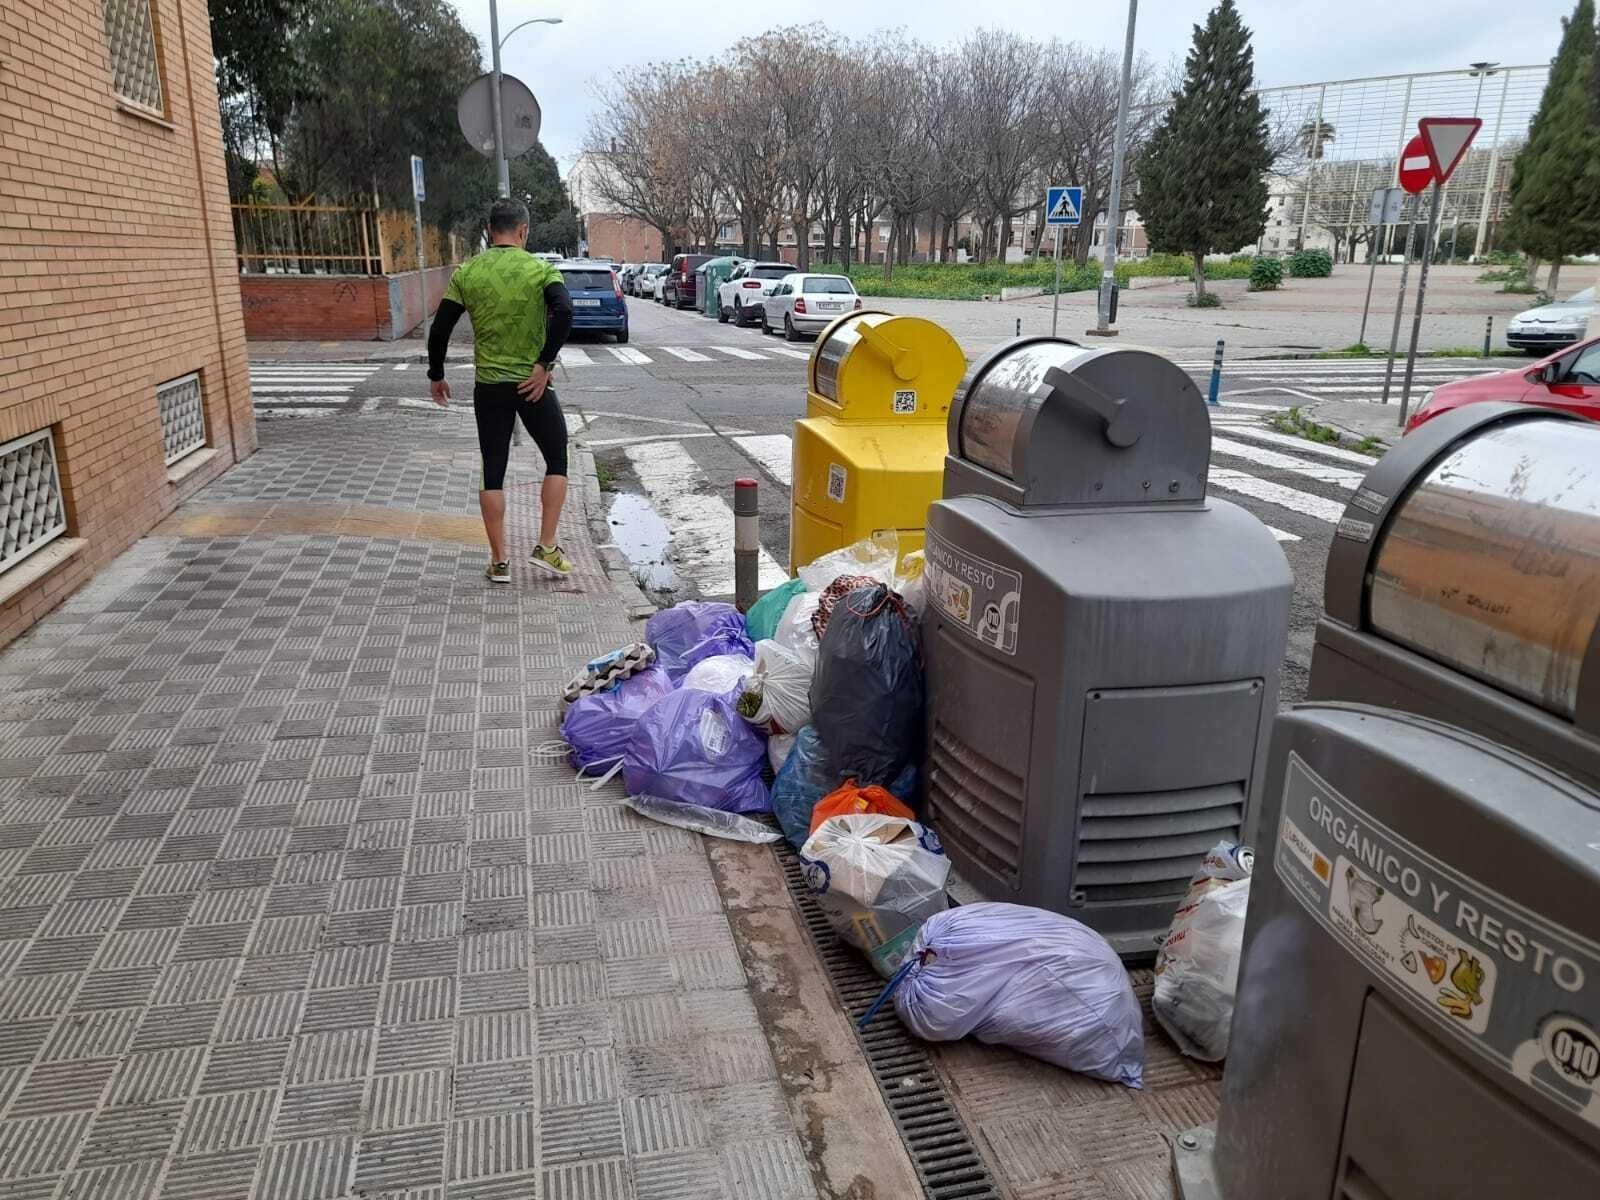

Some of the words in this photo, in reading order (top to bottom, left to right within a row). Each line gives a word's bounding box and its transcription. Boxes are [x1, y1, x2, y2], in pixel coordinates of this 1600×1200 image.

[954, 559, 961, 573] Y
[961, 561, 995, 590] RESTO
[1308, 796, 1421, 897] ORGÁNICO
[1430, 884, 1450, 914] Y
[1456, 900, 1585, 992] RESTO
[1554, 1030, 1599, 1078] 010
